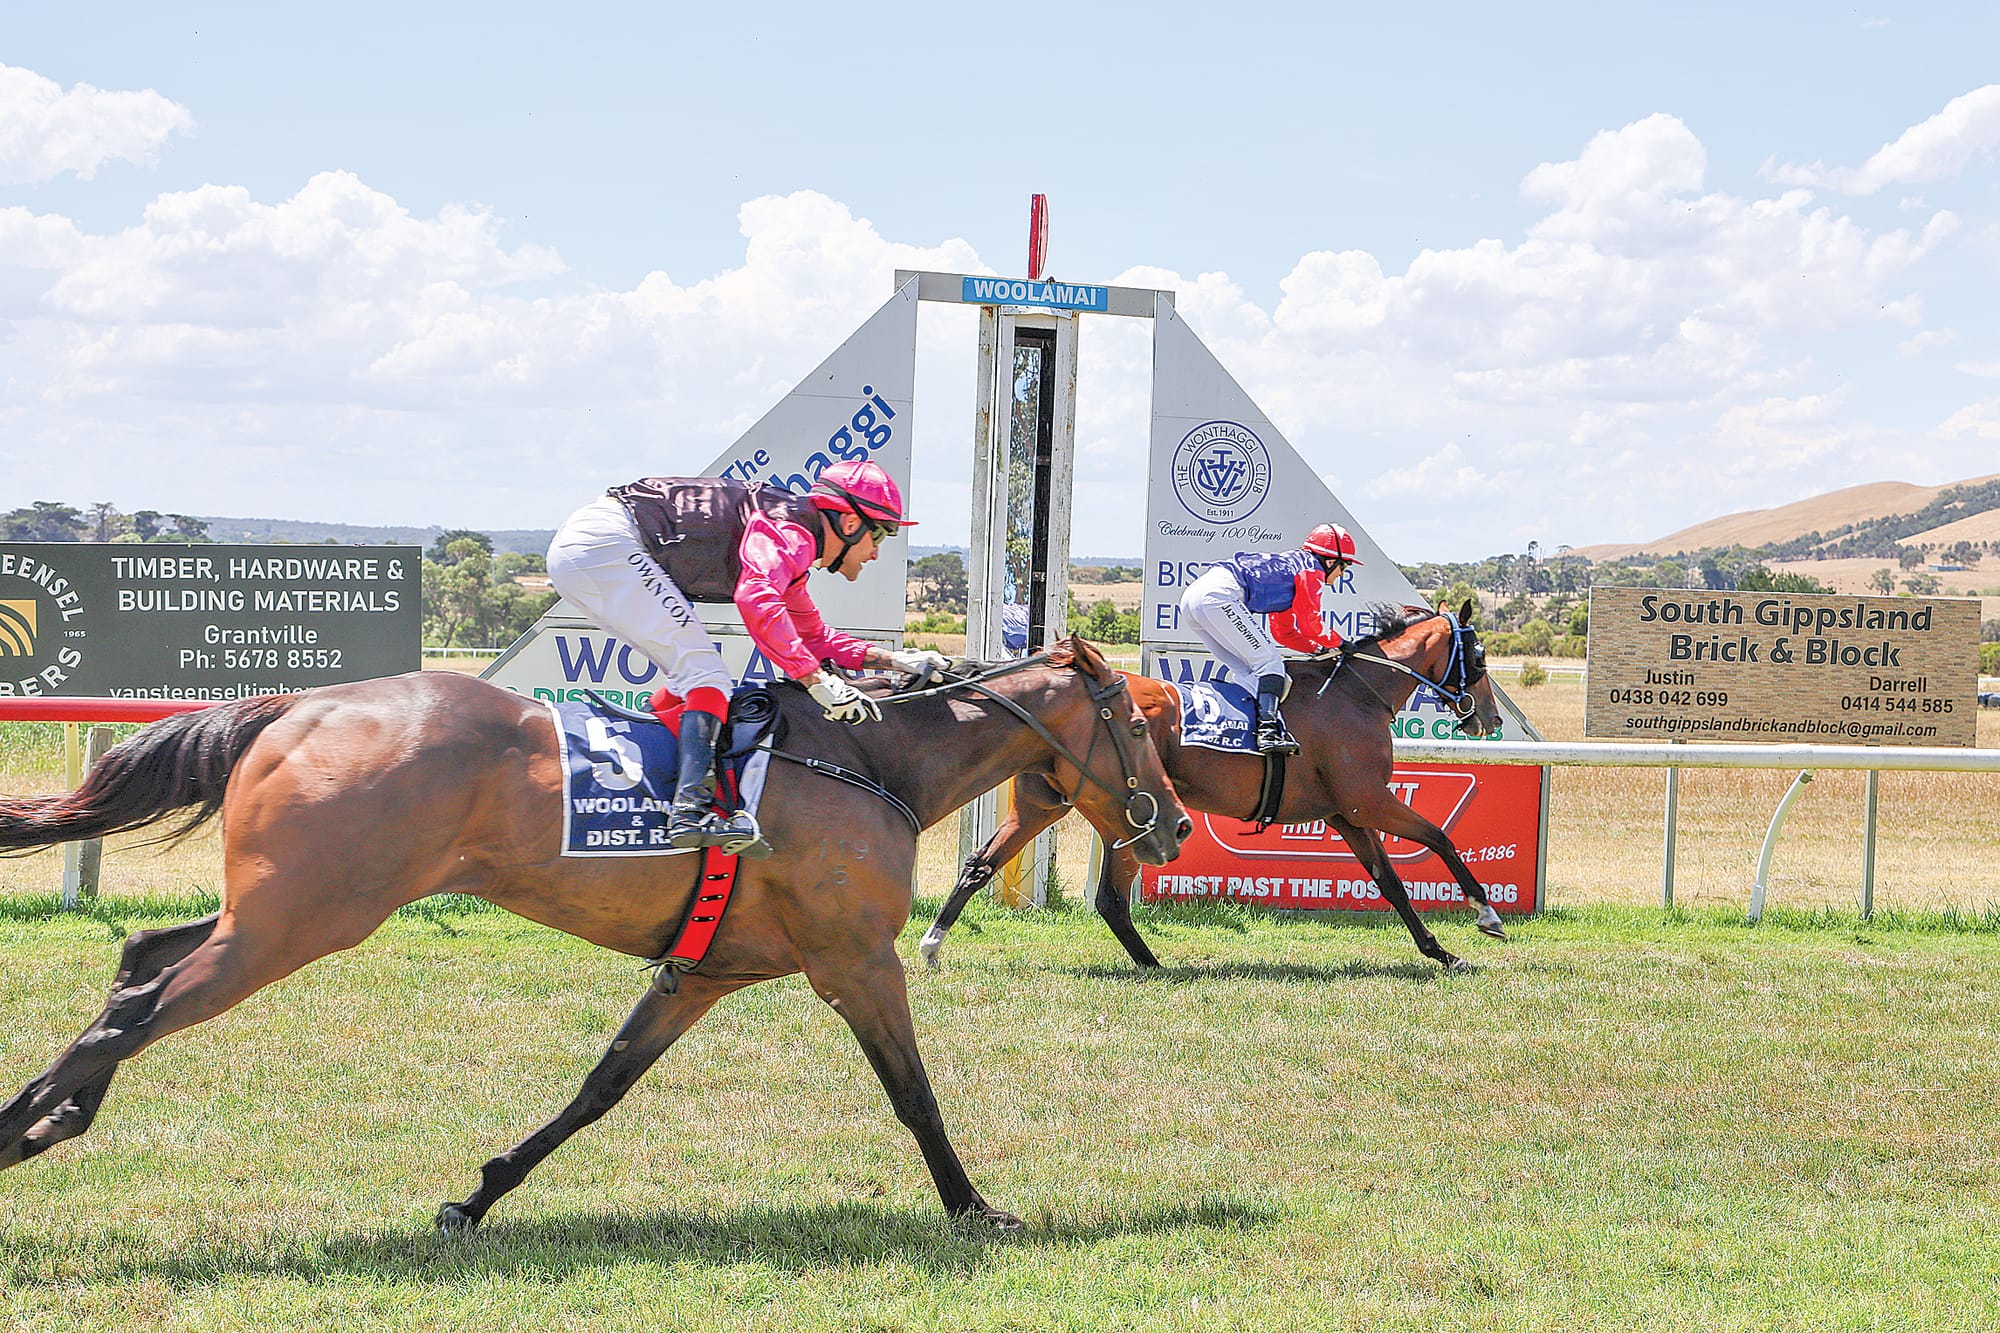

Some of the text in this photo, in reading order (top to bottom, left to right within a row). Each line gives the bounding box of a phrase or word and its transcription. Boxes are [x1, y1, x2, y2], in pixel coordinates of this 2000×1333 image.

[974, 280, 1096, 305] WOOLAMAI
[769, 385, 896, 496] haggi
[719, 449, 770, 481] The
[1177, 426, 1266, 494] THE WONTHAGGI CLUB
[1219, 509, 1234, 517] 1911
[1157, 520, 1282, 543] Celebrating 100 Years
[111, 557, 405, 583] TIMBER, HARDWARE &
[118, 590, 400, 612] BUILDING MATERIALS
[662, 596, 694, 627] COX
[1640, 596, 1932, 635] South Gippsland
[63, 630, 87, 638] 1965
[204, 625, 318, 645] Grantville
[1231, 615, 1261, 650] TRENWITH
[180, 650, 343, 669] Ph: 5678 8552
[1670, 634, 1902, 667] Brick & Block
[1644, 669, 1695, 686] Justin
[1869, 676, 1927, 692] Darrell
[1610, 689, 1728, 707] 0438 042 699
[1841, 696, 1953, 714] 0414 544 585
[1432, 719, 1503, 740] CLB
[1626, 716, 1937, 738] southgippslandbrickandblock@gmail.com
[585, 717, 643, 791] 5
[631, 815, 644, 827] &
[586, 829, 672, 846] DIST. R.
[1157, 875, 1224, 896] FIRST
[1227, 877, 1283, 897] PAST
[1288, 879, 1332, 898] THE
[1337, 880, 1381, 899] POS
[1402, 882, 1464, 902] SINCE
